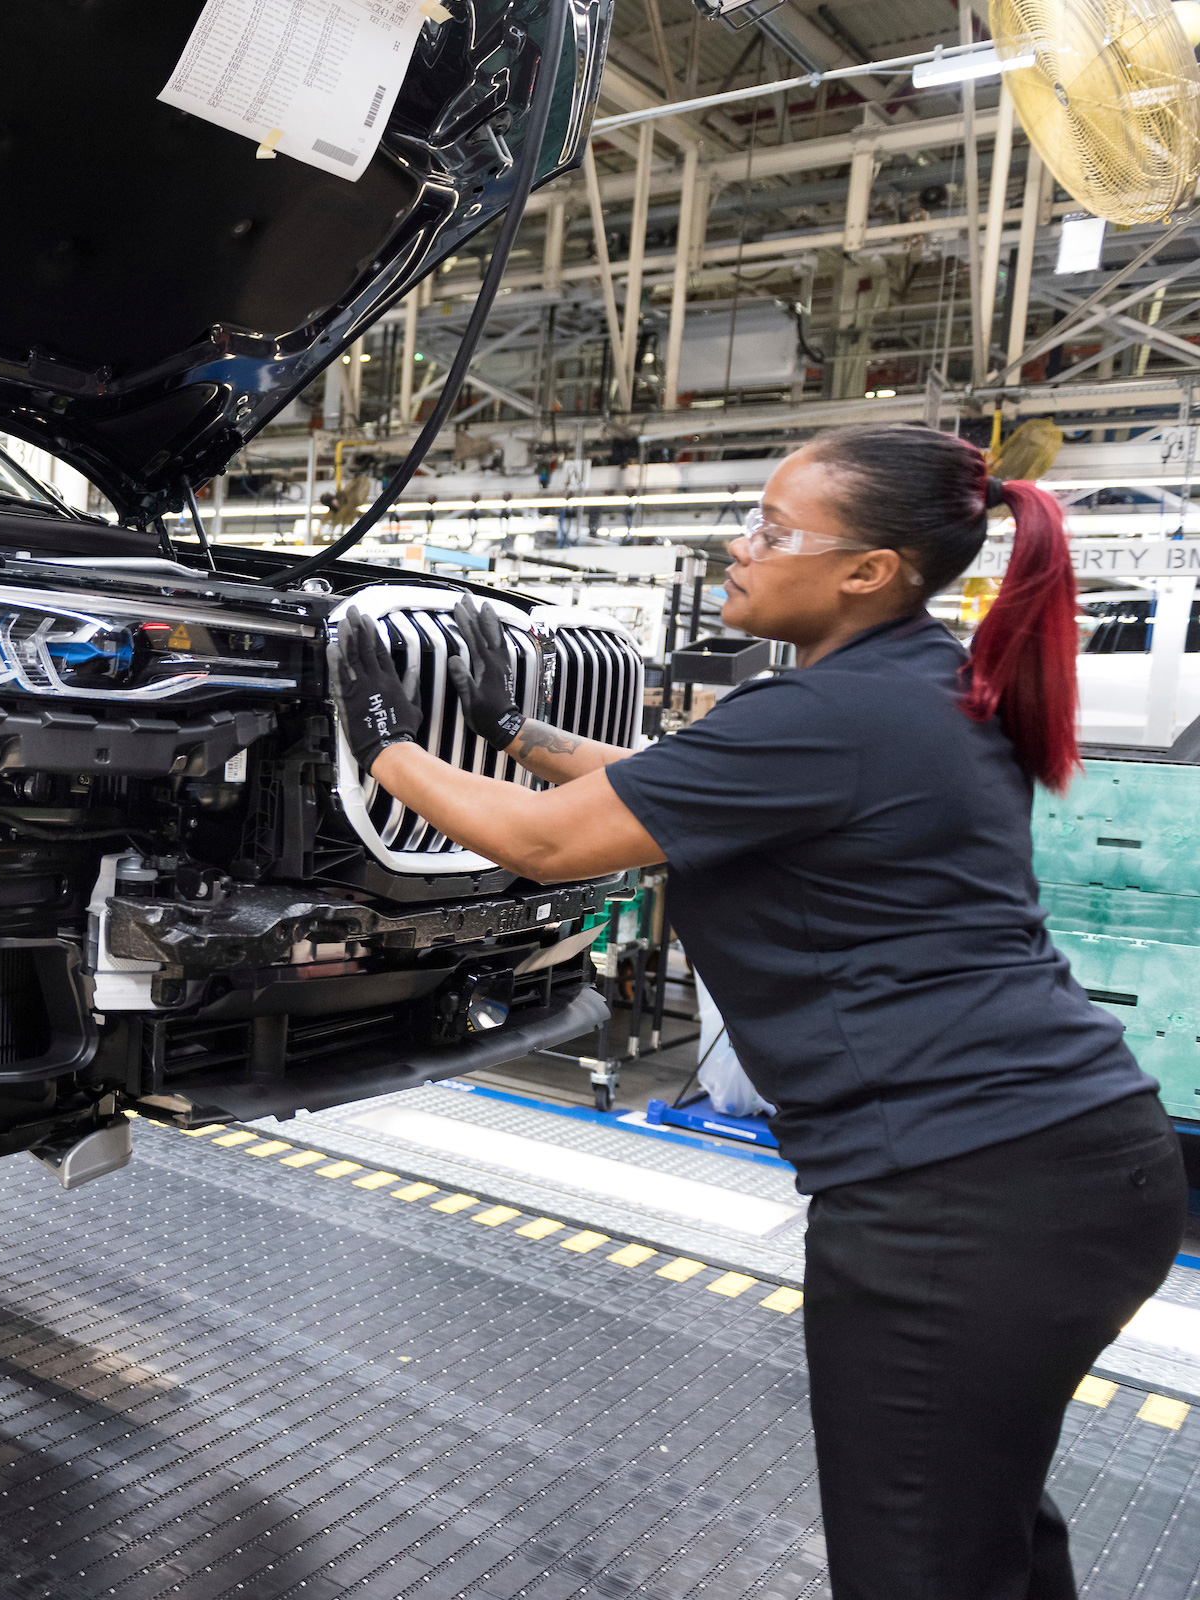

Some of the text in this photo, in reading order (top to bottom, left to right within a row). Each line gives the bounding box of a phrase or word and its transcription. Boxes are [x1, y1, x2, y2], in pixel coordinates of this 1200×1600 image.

[253, 6, 263, 16] 441
[396, 1, 411, 14] GAS
[250, 13, 261, 23] 442
[290, 8, 301, 18] 5AZ
[202, 16, 216, 26] 255
[389, 13, 404, 26] AUT
[199, 22, 212, 32] 258
[247, 20, 258, 30] 453
[286, 23, 297, 32] 610
[196, 29, 209, 39] 2TB
[244, 27, 255, 36] 456
[283, 30, 294, 39] 645
[193, 36, 206, 46] 2VB
[281, 37, 291, 46] 655
[392, 40, 401, 51] H
[190, 43, 202, 53] 302
[278, 44, 289, 53] 65A
[187, 50, 199, 59] 319
[275, 50, 287, 60] 6AC
[183, 57, 196, 66] 322
[180, 63, 193, 73] 323
[177, 70, 190, 79] 328
[221, 74, 233, 83] 4UR
[266, 71, 277, 80] 6C4
[173, 77, 187, 86] 3AT
[218, 80, 229, 90] 5A1
[170, 83, 183, 92] 3MB
[214, 87, 227, 96] 5AC
[207, 99, 219, 108] 5AP
[978, 548, 1148, 570] PRERTY
[369, 693, 391, 737] HyFlex
